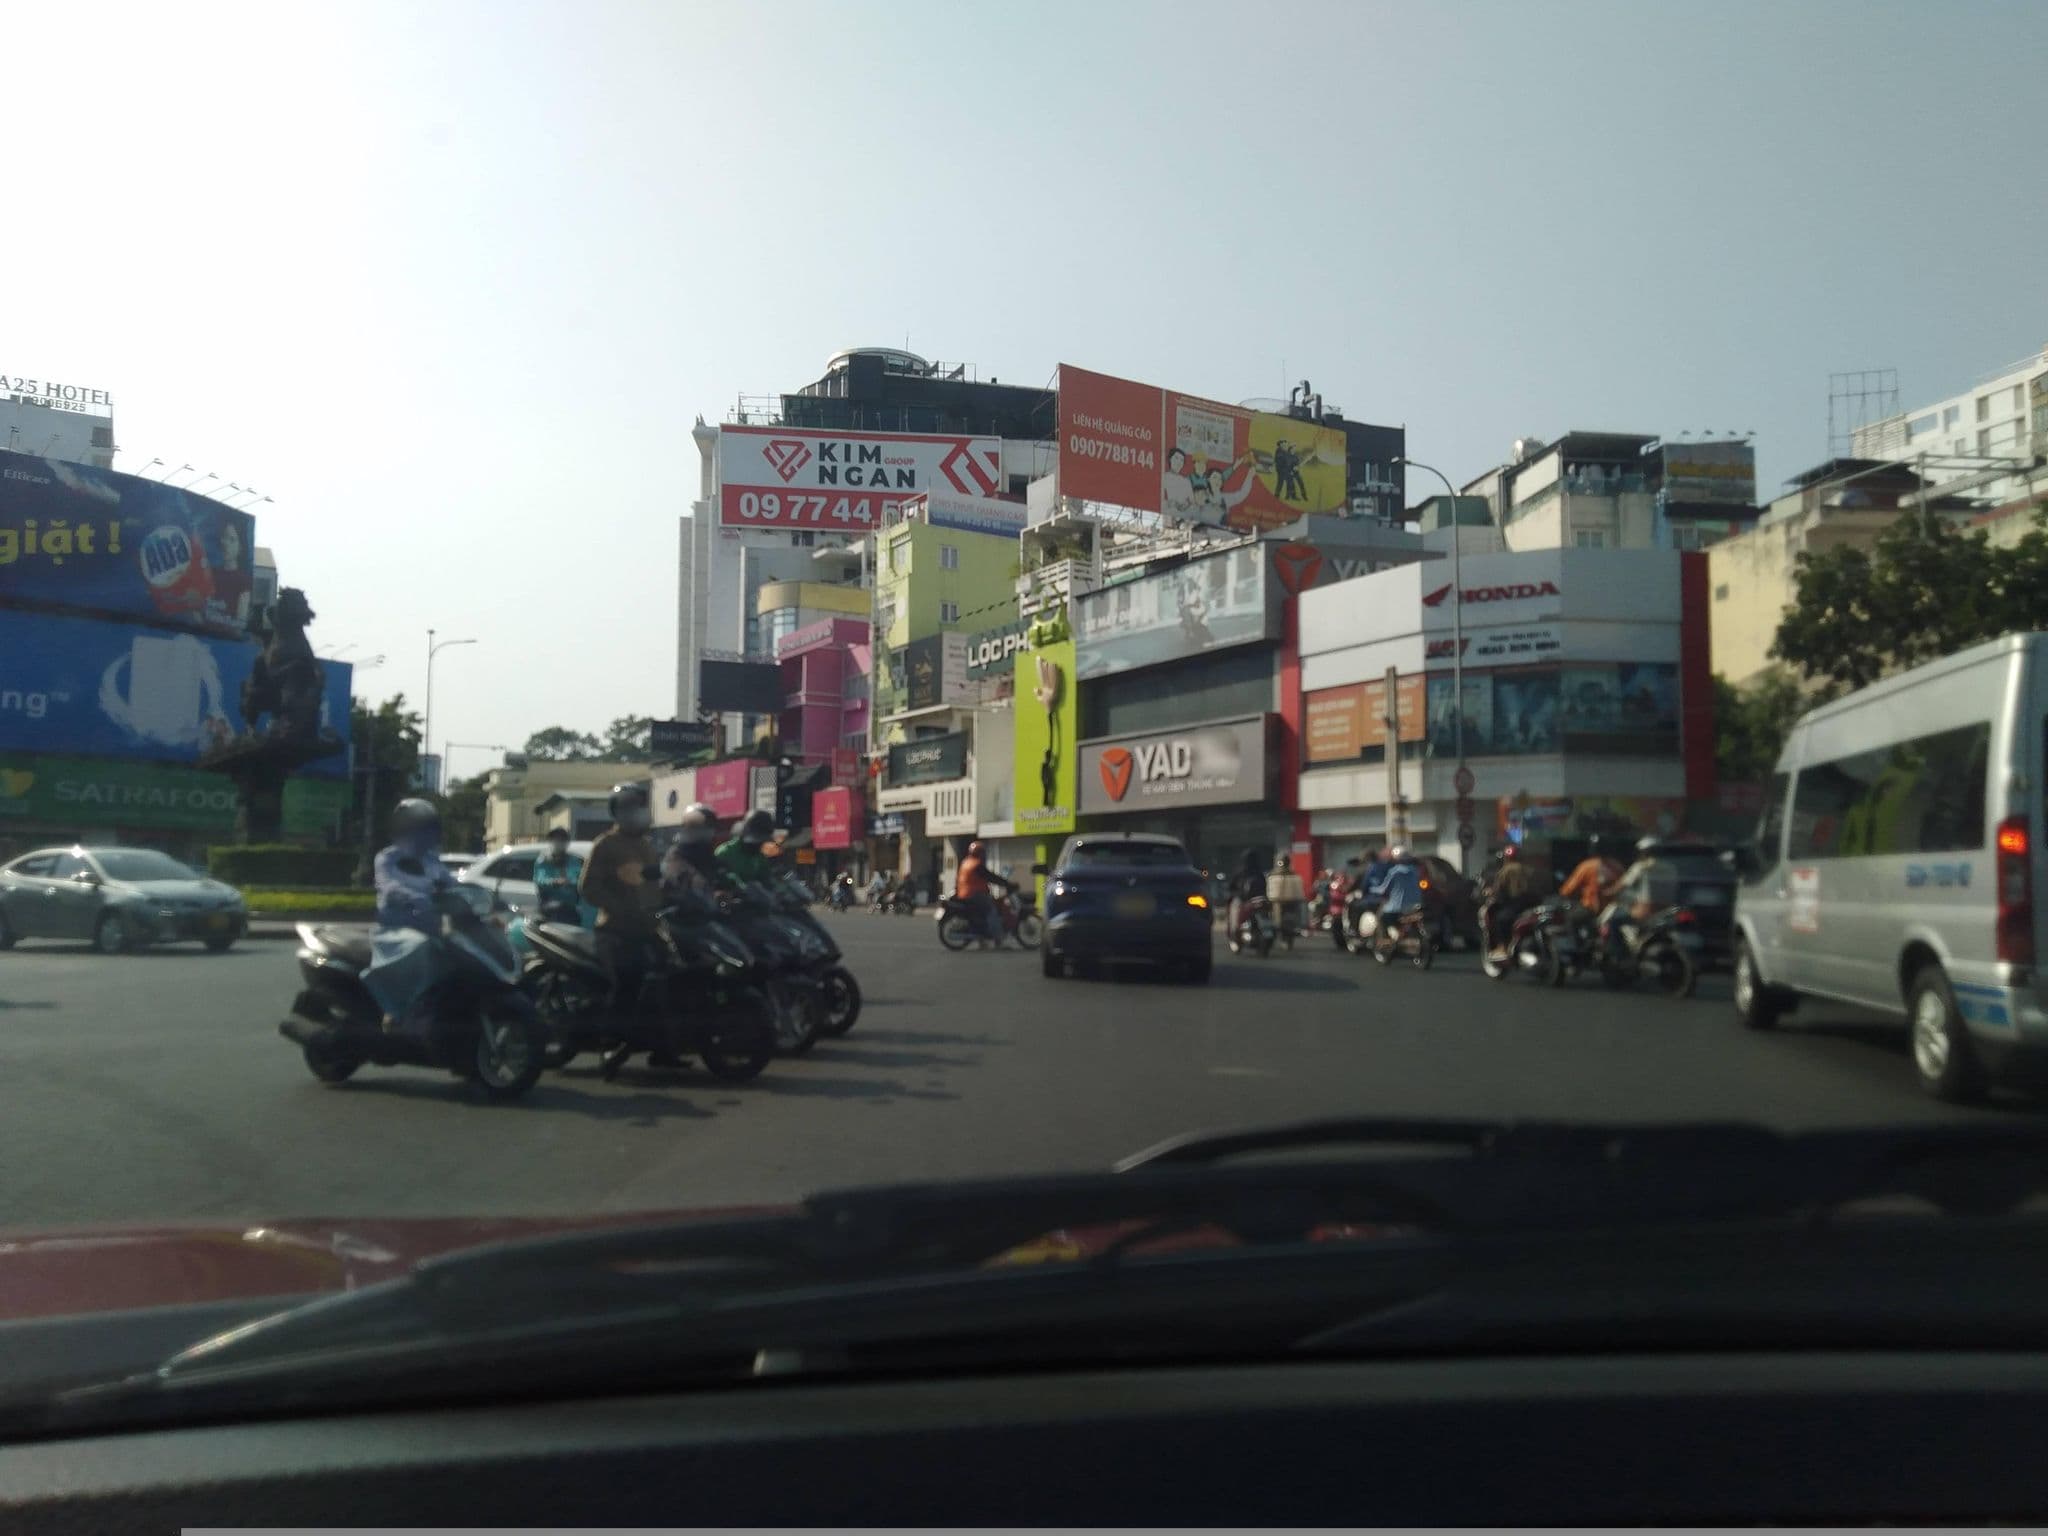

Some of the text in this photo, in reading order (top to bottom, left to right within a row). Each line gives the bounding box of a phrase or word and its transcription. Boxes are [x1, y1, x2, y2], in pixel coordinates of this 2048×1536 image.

[0, 375, 112, 406] A25 HOTEL
[818, 442, 915, 466] KIM GROUP
[1070, 434, 1154, 470] 0907788144
[818, 465, 916, 488] NGAN
[0, 520, 96, 566] giặt
[1458, 580, 1560, 605] HONDA
